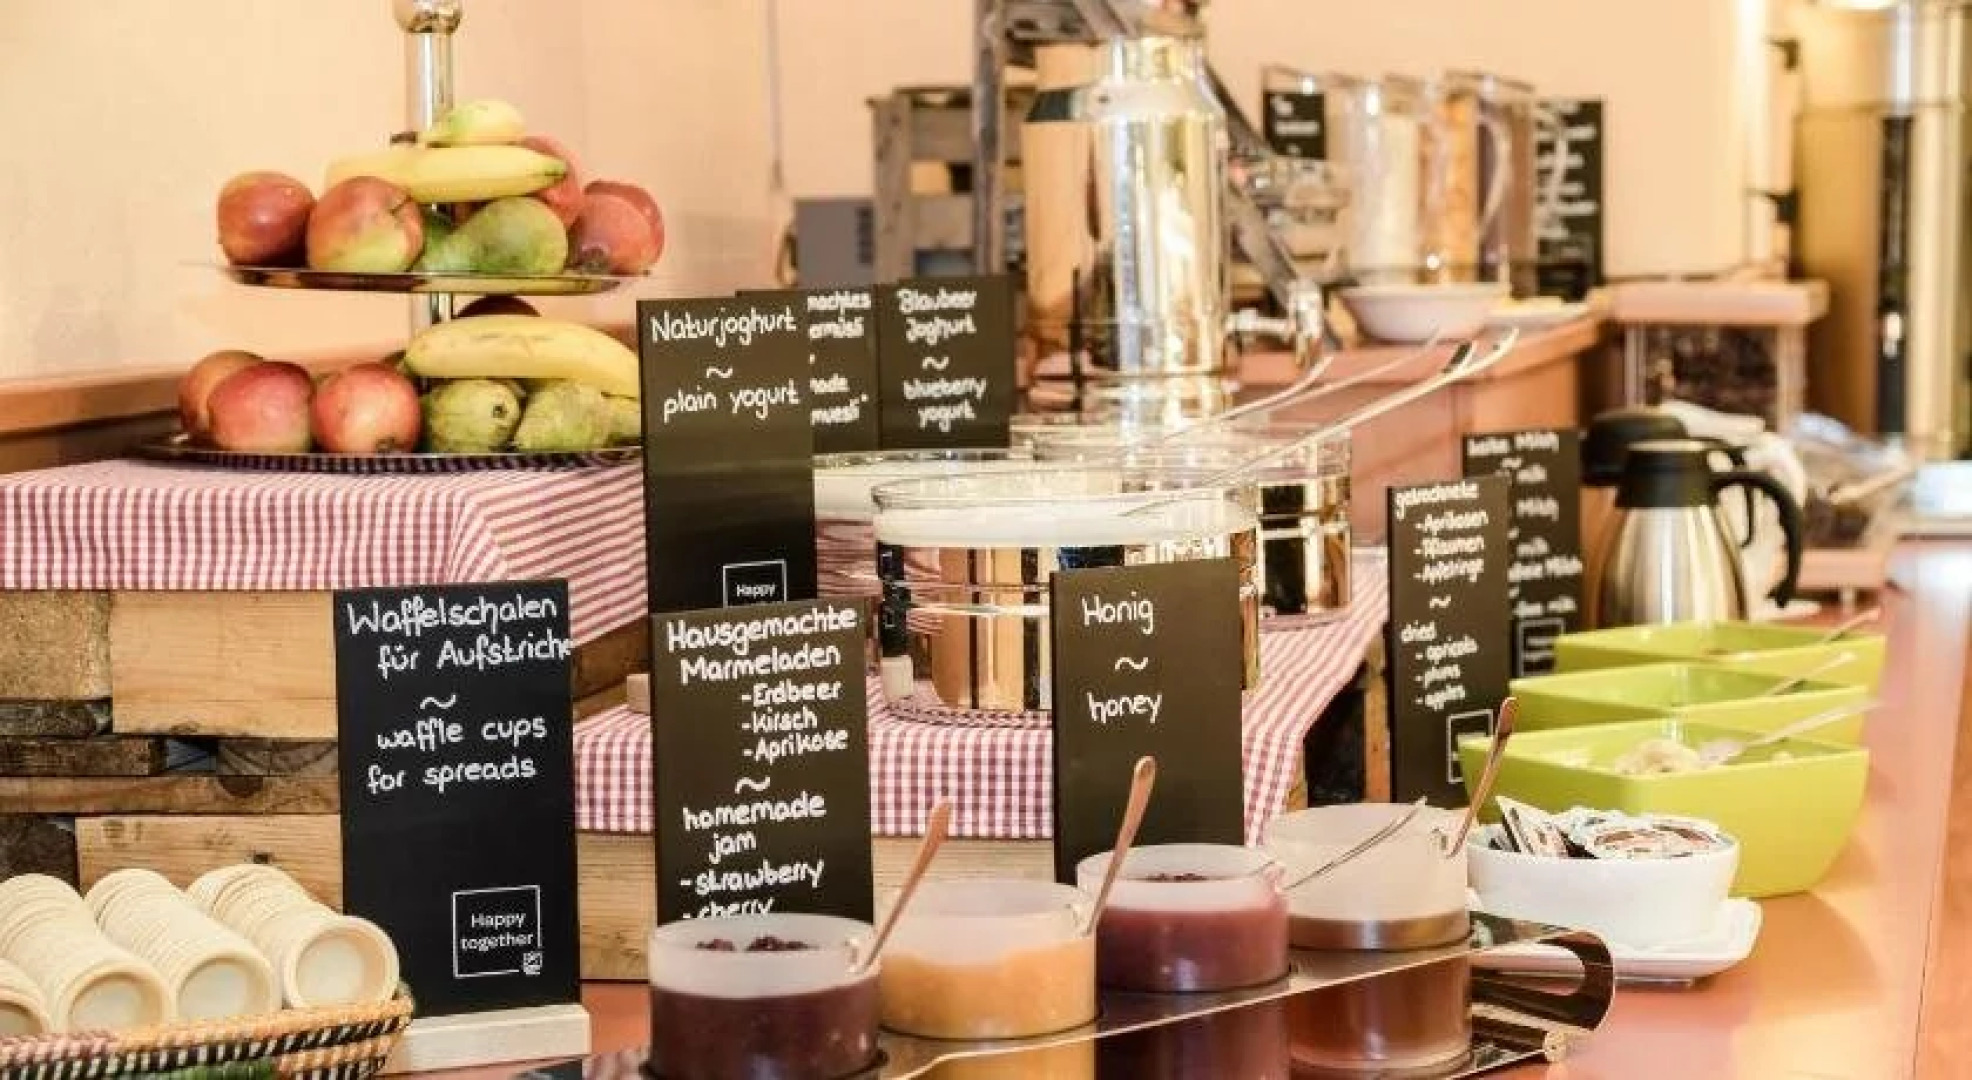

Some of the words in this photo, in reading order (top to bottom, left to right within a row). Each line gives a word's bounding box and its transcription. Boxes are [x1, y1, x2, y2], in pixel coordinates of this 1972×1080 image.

[896, 288, 977, 314] Blaubeer
[650, 306, 797, 348] Naturjoghurt
[905, 314, 977, 346] Joghurt
[663, 384, 717, 424] plain
[729, 379, 799, 421] yogurt
[903, 377, 987, 402] blueberry
[917, 398, 976, 433] yogurt
[736, 584, 776, 598] Happy
[347, 595, 557, 635] Waffelschalen
[666, 605, 858, 655] Hausgemachte
[1081, 591, 1154, 635] Honig
[377, 644, 419, 680] für
[680, 643, 841, 685] Marmeladen
[1086, 692, 1163, 724] honey
[377, 717, 463, 752] waffle
[481, 717, 548, 748] cups
[367, 764, 405, 795] for
[422, 755, 536, 793] spreads
[682, 790, 827, 833] homemade
[708, 830, 757, 865] jam
[471, 913, 526, 930] Happy
[461, 931, 534, 952] together
